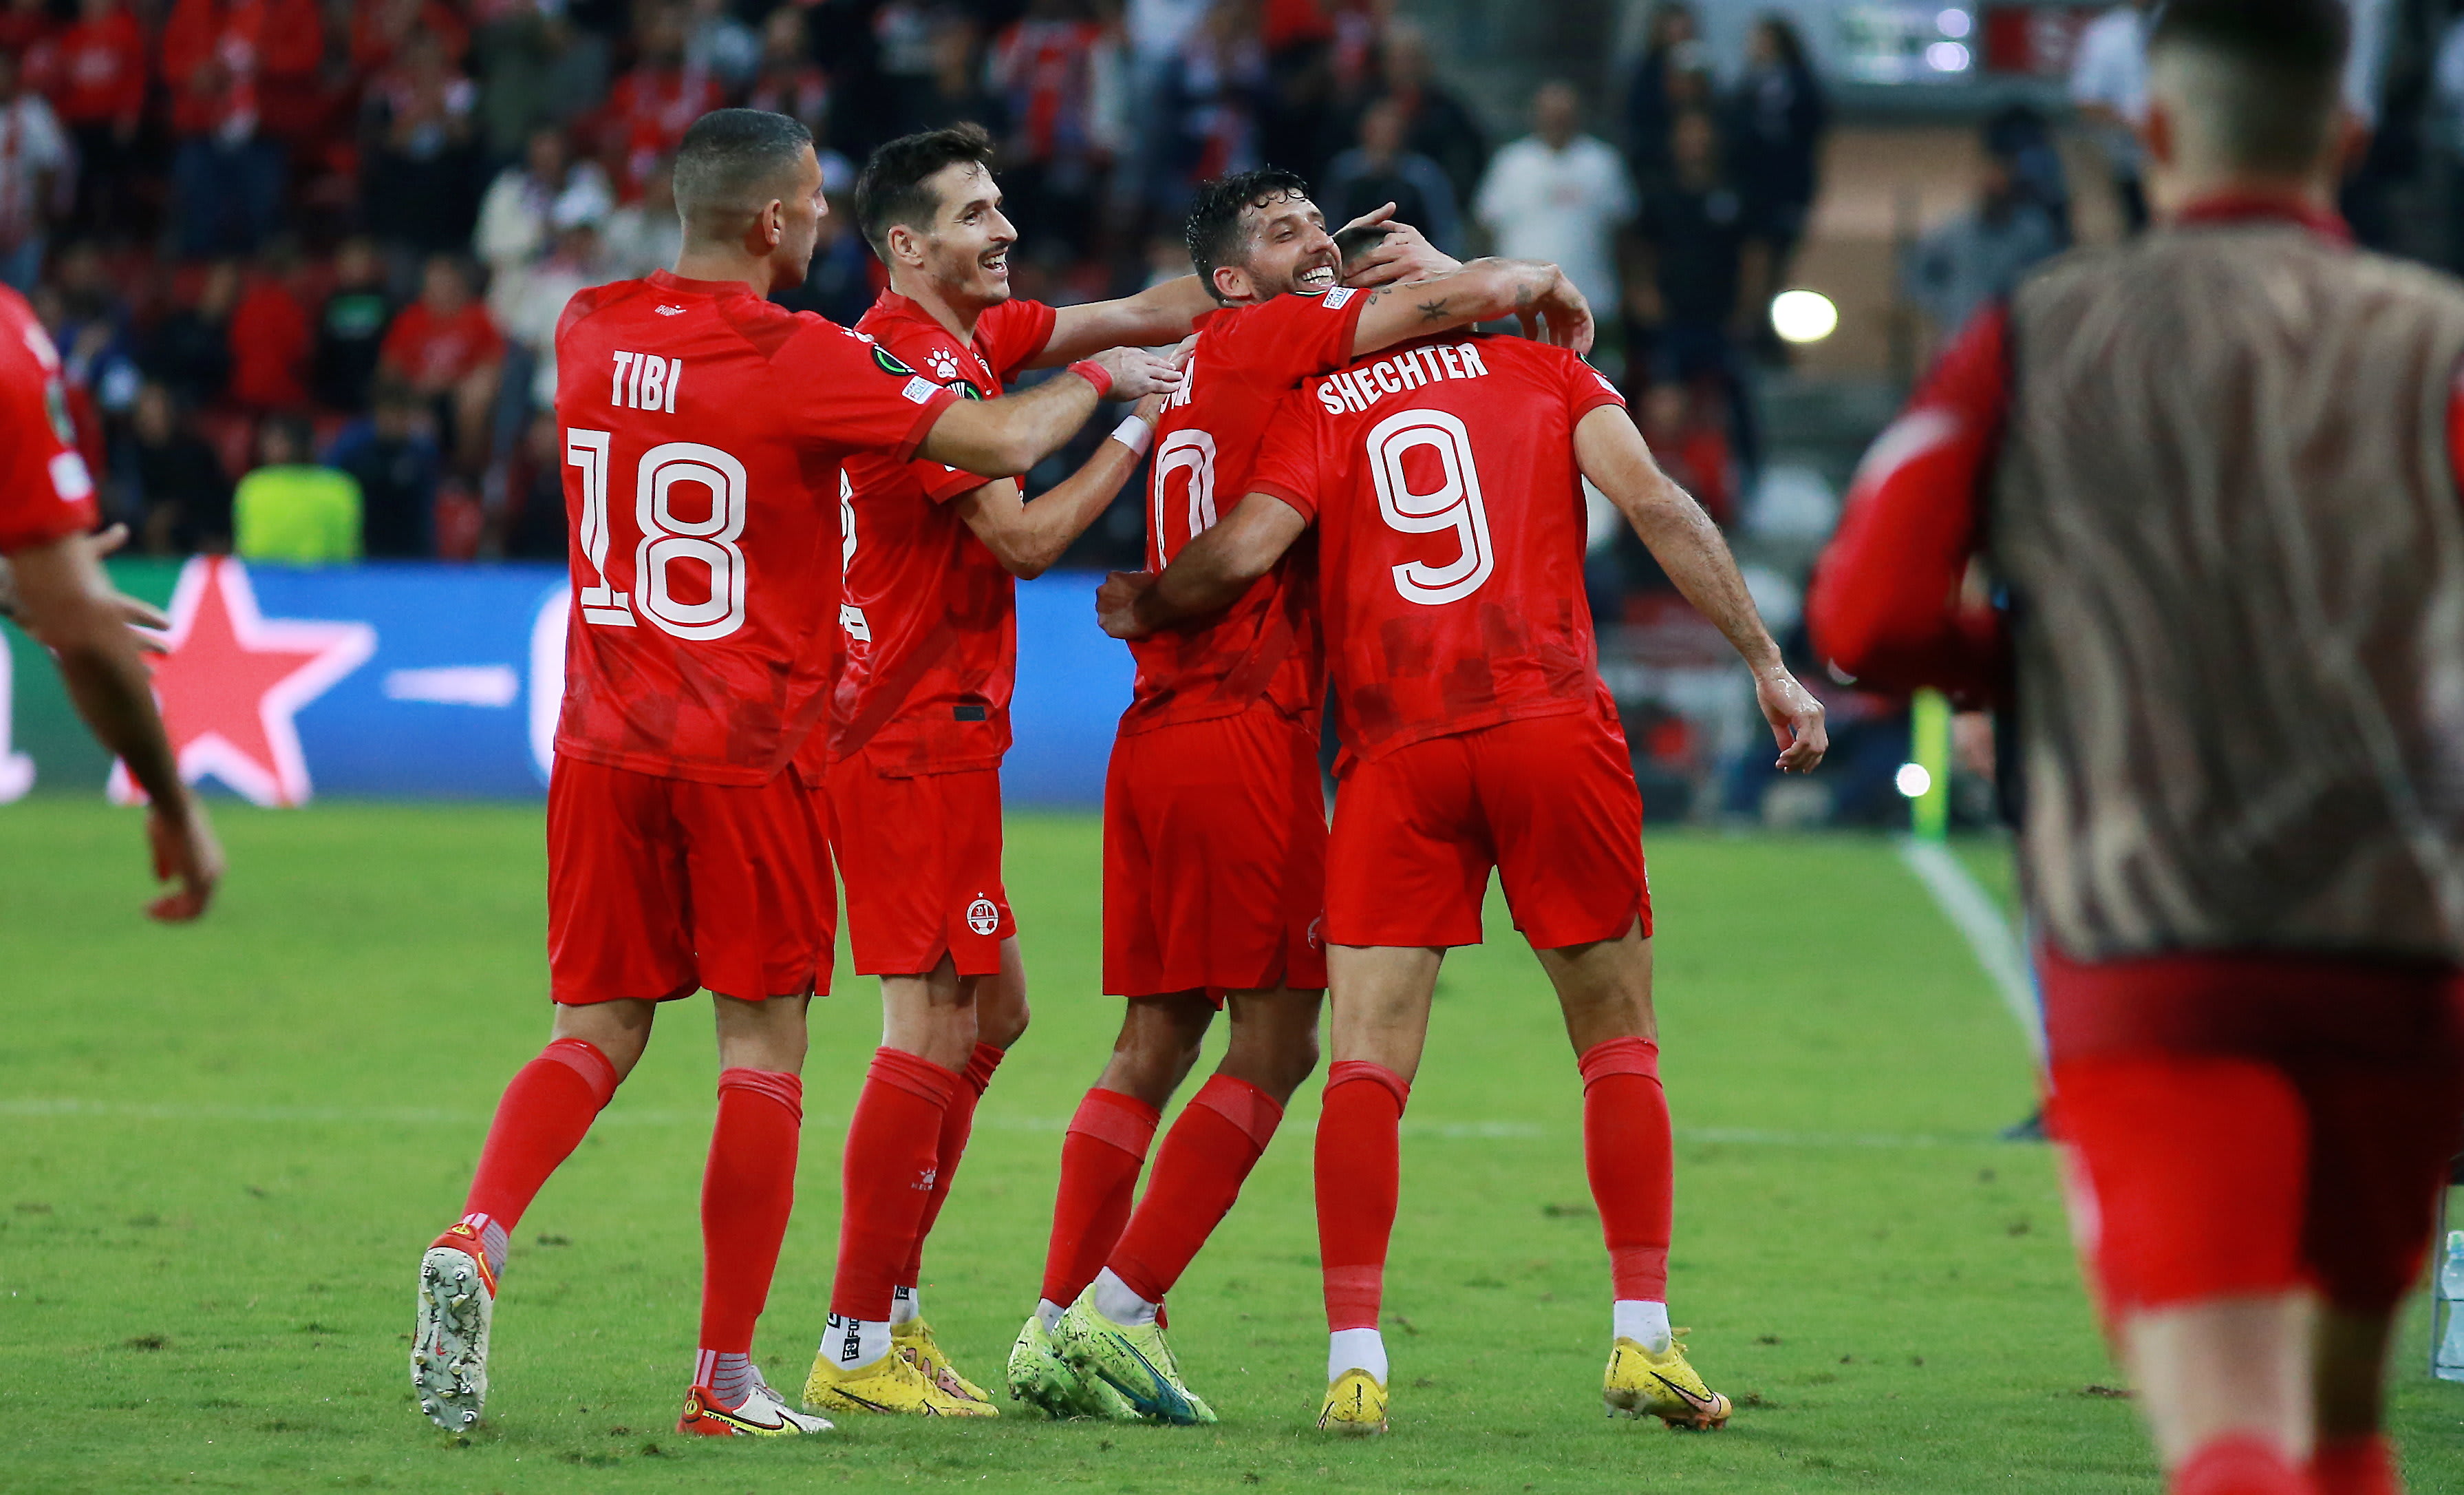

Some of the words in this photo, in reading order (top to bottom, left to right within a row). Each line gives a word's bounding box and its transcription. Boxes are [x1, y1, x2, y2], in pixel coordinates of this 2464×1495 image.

[611, 350, 682, 414] TIBI
[1317, 342, 1489, 415] SHECHTER
[566, 427, 747, 641] 18
[1366, 409, 1495, 606] 9
